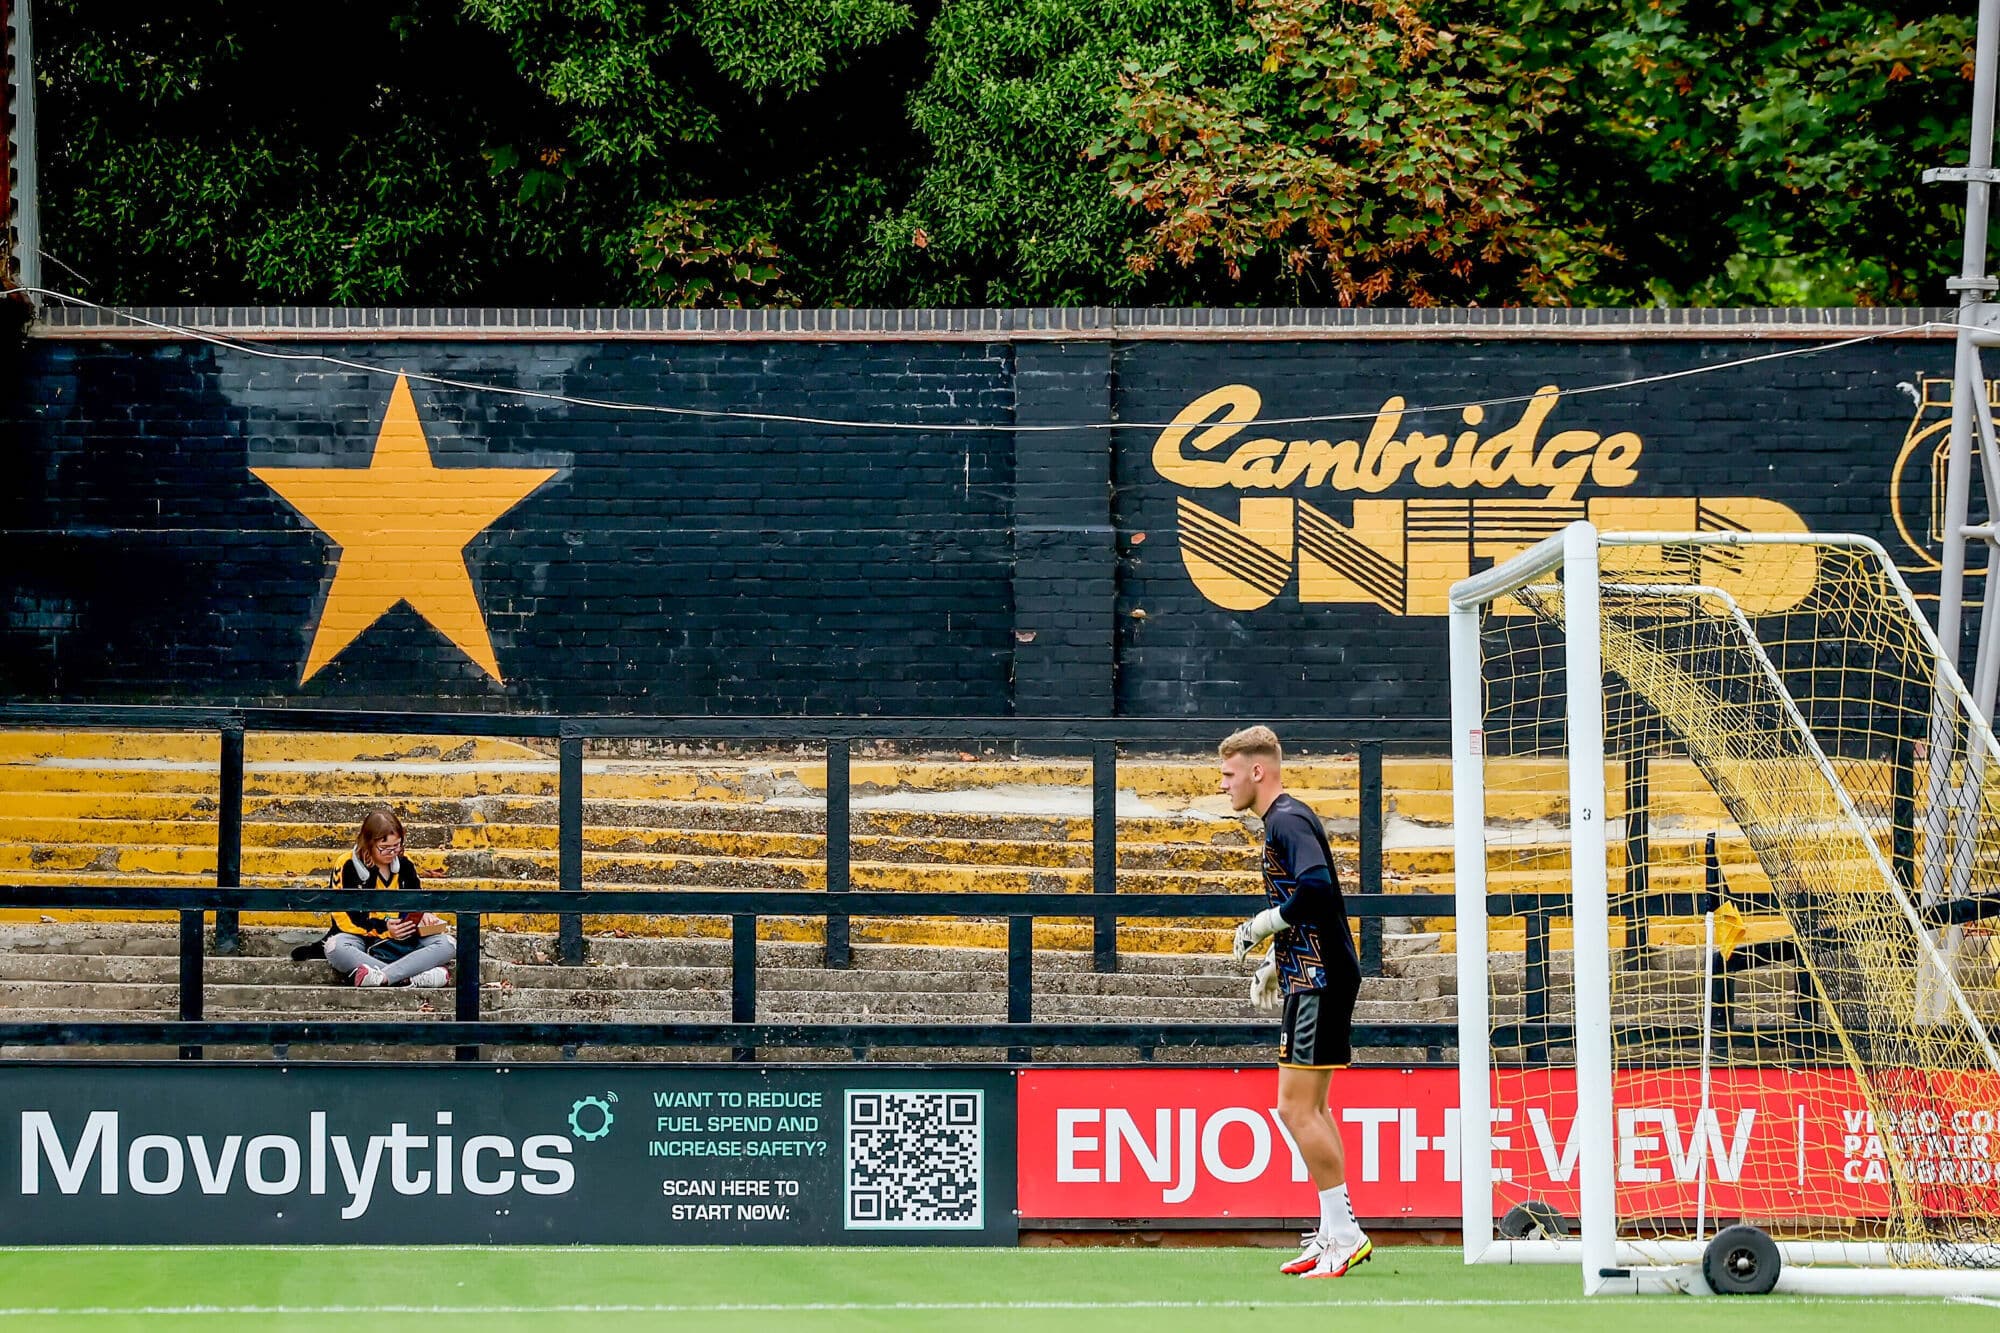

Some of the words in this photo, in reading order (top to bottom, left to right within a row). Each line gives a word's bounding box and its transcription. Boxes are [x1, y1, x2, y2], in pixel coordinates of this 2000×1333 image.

[1150, 384, 1644, 502] Cambridge
[1176, 496, 1817, 617] UNITED
[1582, 807, 1592, 821] 3
[653, 1092, 714, 1108] WANT
[717, 1092, 743, 1108] TO
[747, 1092, 823, 1108] REDUCE
[657, 1117, 704, 1132] FUEL
[707, 1116, 772, 1132] SPEND
[776, 1116, 819, 1132] AND
[1952, 1110, 2000, 1133] CO
[648, 1141, 742, 1157] INCREASE
[745, 1141, 828, 1157] SAFETY?
[1526, 1108, 1756, 1183] VEW
[20, 1111, 576, 1220] Movolytics
[662, 1180, 717, 1196] SCAN
[720, 1180, 770, 1196] HERE
[773, 1180, 800, 1196] TO
[671, 1205, 730, 1220] START
[737, 1205, 791, 1221] NOW:
